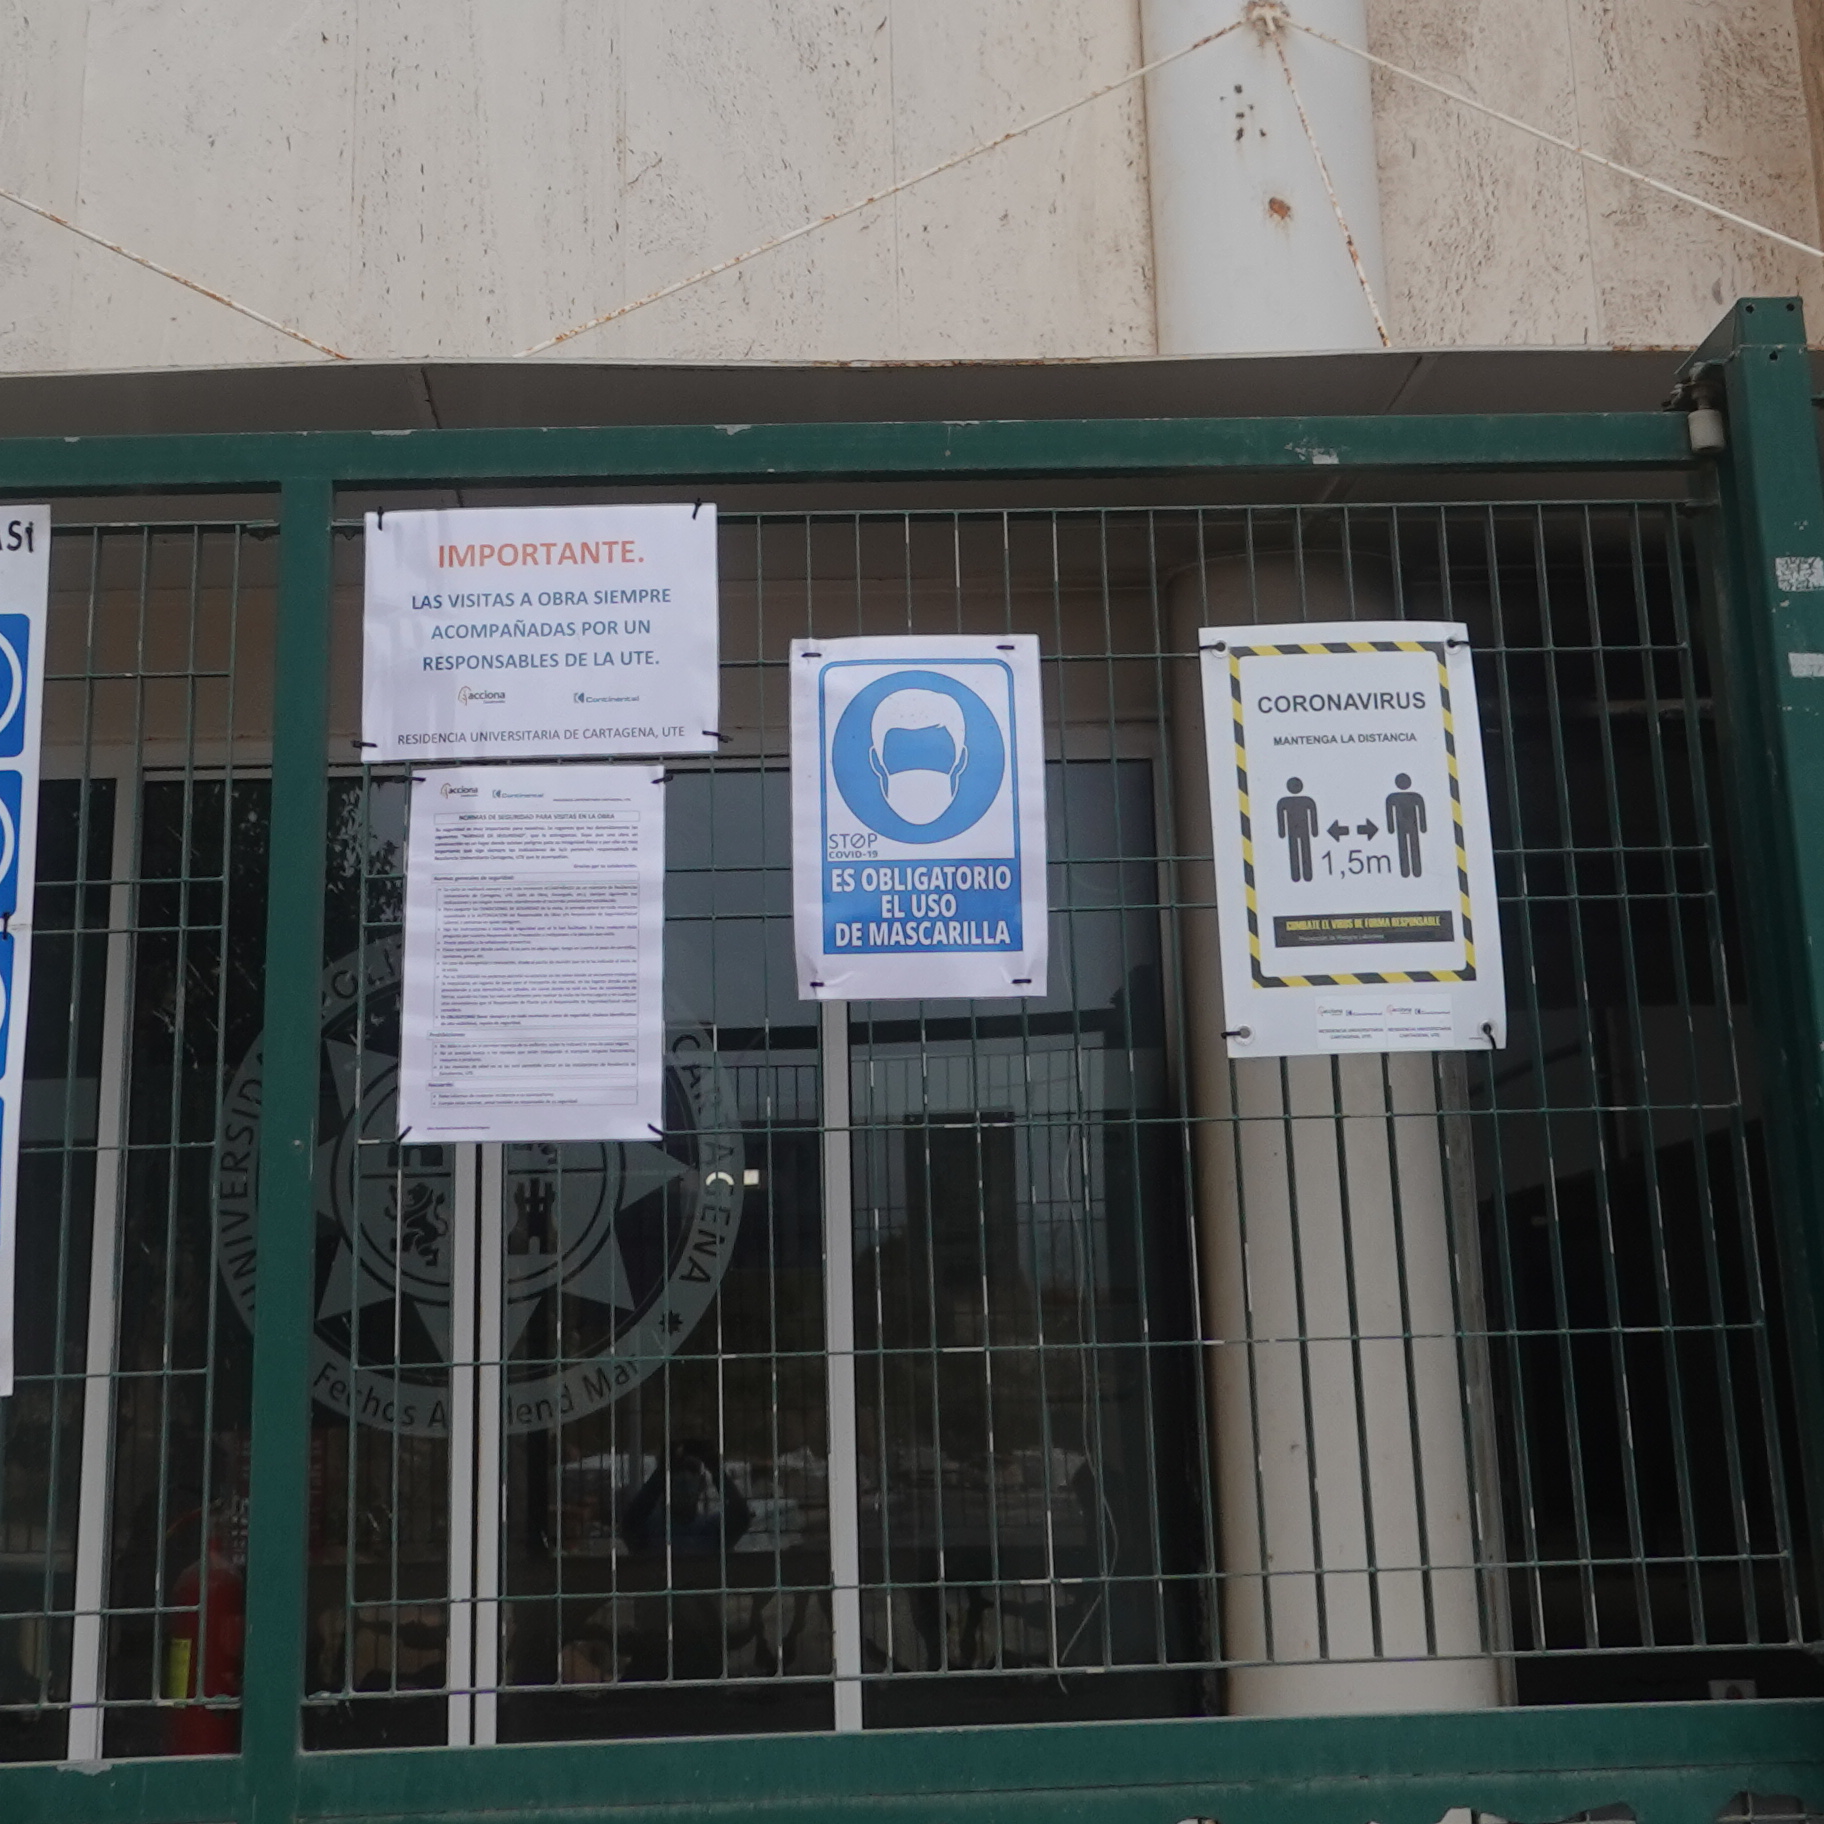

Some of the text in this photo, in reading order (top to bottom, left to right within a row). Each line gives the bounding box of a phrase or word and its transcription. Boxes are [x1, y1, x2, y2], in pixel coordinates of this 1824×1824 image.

[438, 540, 645, 568] IMPORTANTE.
[412, 588, 672, 610] LAS VISITAS A OBRA SIEMPRE
[431, 619, 651, 640] ACOMPAÑADAS POR UN
[422, 650, 661, 671] RESPONSABLES DE LA UTE.
[1257, 691, 1426, 714] CORONAVIRUS
[398, 726, 685, 746] RESIDENCIA UNIVERSITARIA DE CARTAGENA, UTE
[1273, 732, 1417, 746] MANTENGA LA DISTANCIA
[829, 850, 878, 859] COVID-19
[1321, 849, 1392, 879] 1,5m
[831, 865, 1012, 893] ES OBLIGATORIO
[881, 893, 957, 919] EL USO
[835, 920, 1011, 947] DE MASCARILLA
